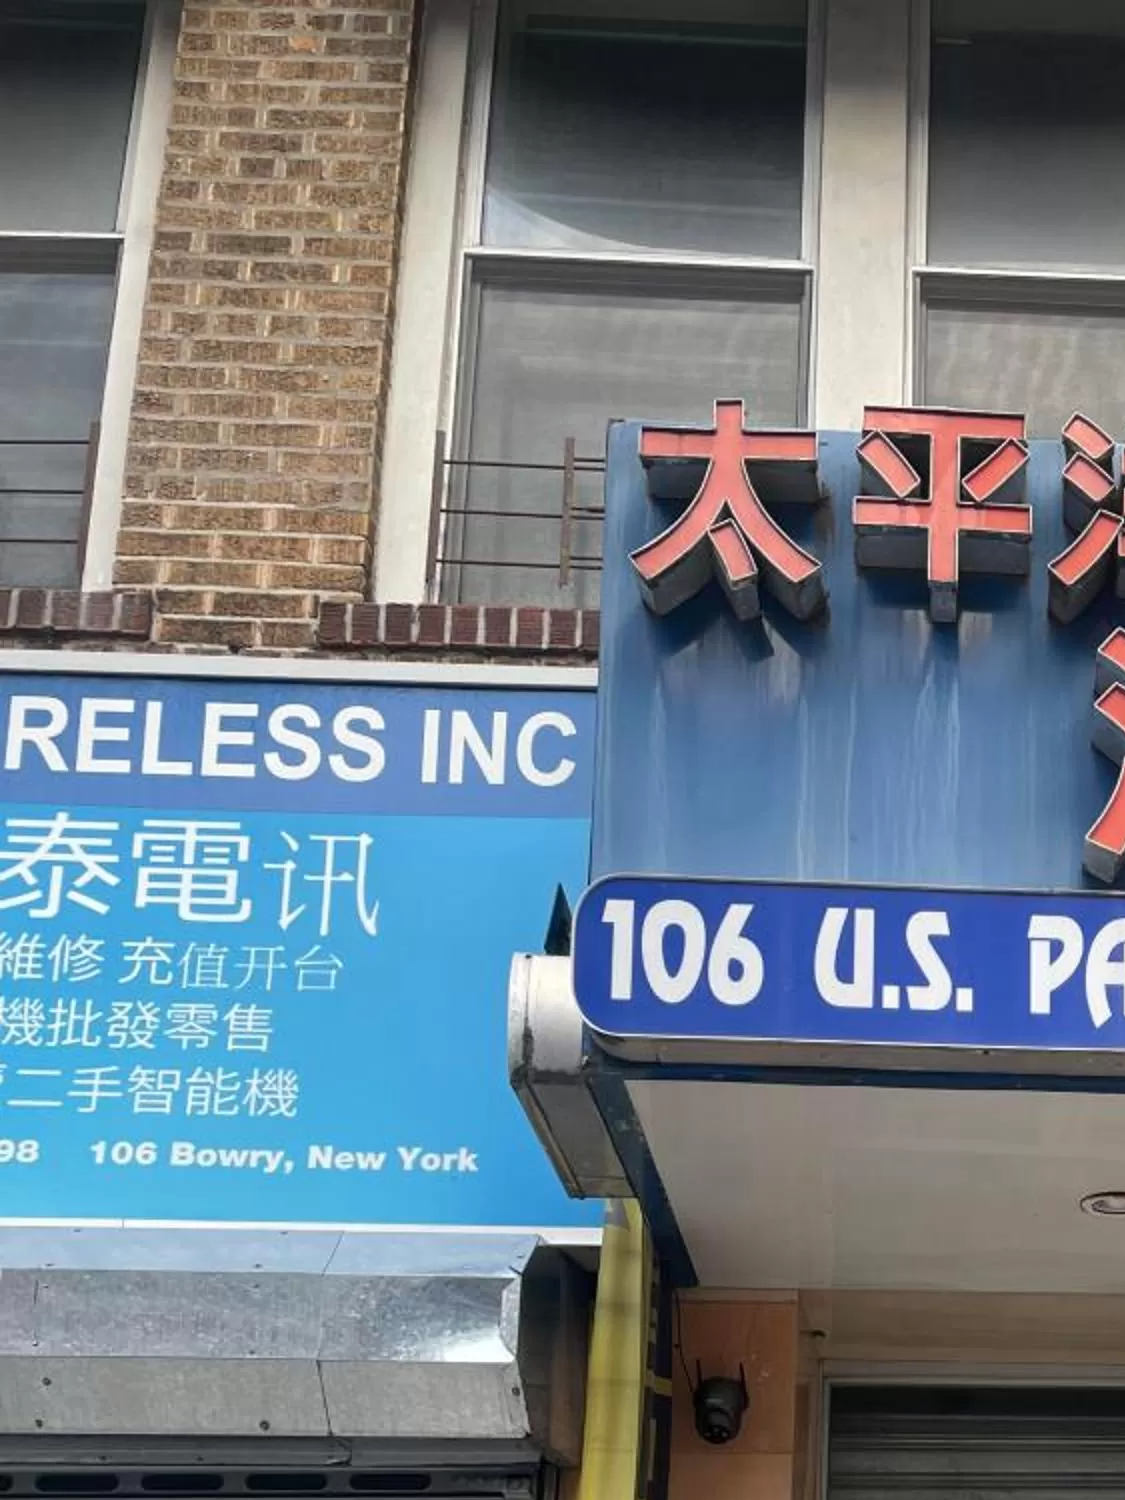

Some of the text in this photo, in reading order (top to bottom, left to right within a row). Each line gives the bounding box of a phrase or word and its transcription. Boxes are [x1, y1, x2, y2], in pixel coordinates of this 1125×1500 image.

[4, 695, 577, 787] RELESS INC
[0, 811, 380, 937] 泰電讯
[601, 898, 764, 1006] 106
[814, 907, 973, 1011] U.S.
[0, 1063, 299, 1120] 二手智能機
[90, 1140, 158, 1166] 106
[170, 1141, 294, 1174] Bowry,
[307, 1145, 386, 1172] New
[397, 1146, 479, 1173] York
